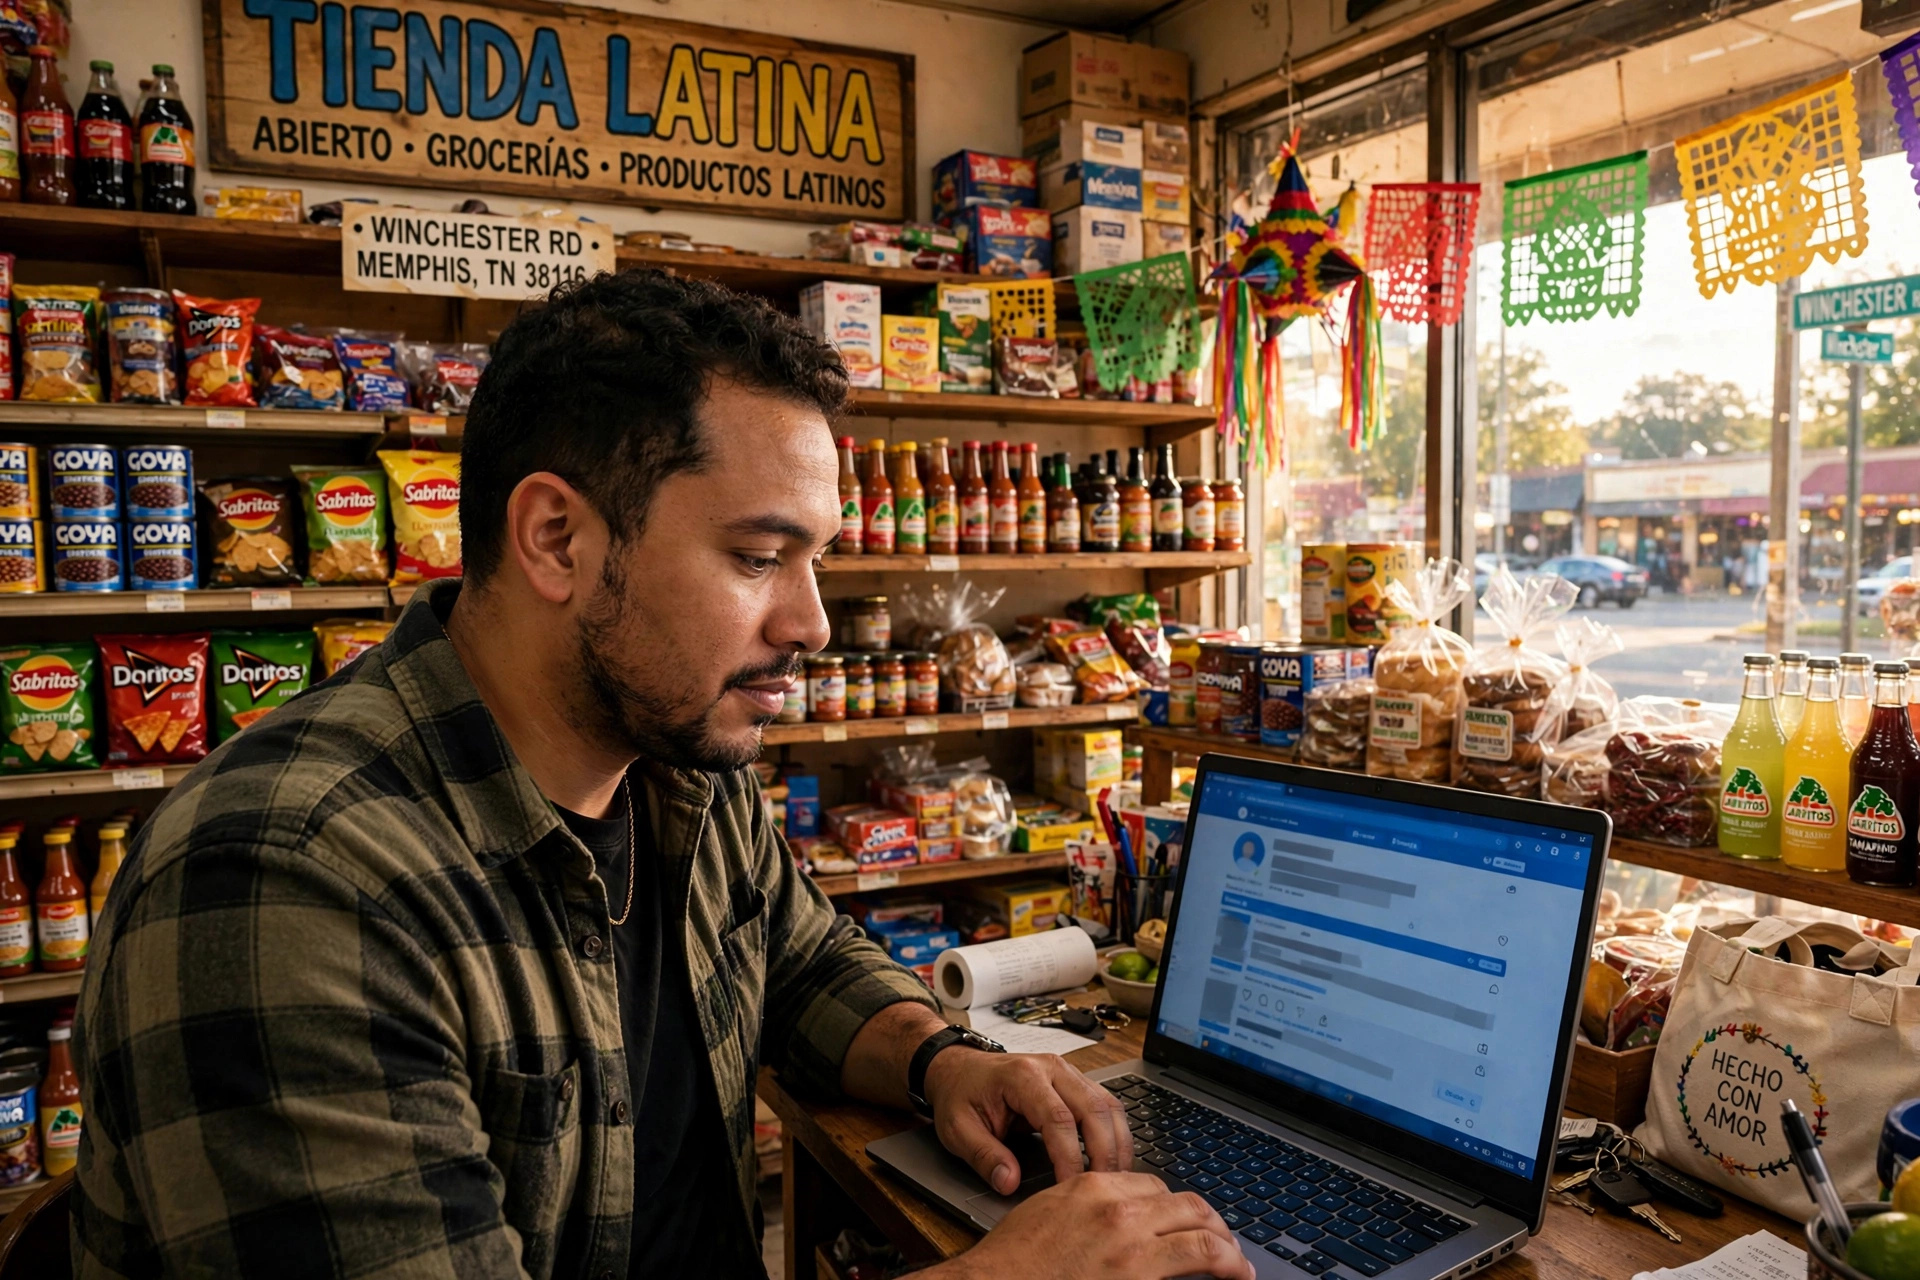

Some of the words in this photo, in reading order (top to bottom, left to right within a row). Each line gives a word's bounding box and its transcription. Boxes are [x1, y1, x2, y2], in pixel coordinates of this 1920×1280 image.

[244, 0, 580, 131] TIENDA
[605, 34, 884, 166] LATINA
[252, 116, 392, 161] ABIERTO
[426, 132, 590, 180] GROCERÍAS
[619, 151, 771, 198] PRODUCTOS
[783, 168, 886, 209] LATINOS
[371, 215, 541, 255] WINCHESTER
[549, 229, 583, 256] RD
[356, 250, 478, 289] MEMPHIS,
[484, 258, 516, 286] TN
[525, 262, 586, 290] 38116
[1799, 282, 1907, 324] WINCHESTER
[188, 315, 241, 336] Doritos
[53, 450, 114, 471] GOYA
[128, 451, 187, 471] GOYA
[219, 497, 280, 518] Sabritas
[317, 492, 376, 511] Sabritas
[56, 523, 117, 545] GOYA
[133, 523, 192, 545] GOYA
[10, 672, 80, 692] Sabritas
[113, 664, 196, 687] Doritos
[222, 664, 301, 685] Doritos
[1711, 1049, 1783, 1092] HECHO
[1717, 1080, 1762, 1114] CON
[1704, 1103, 1767, 1146] AMOR
